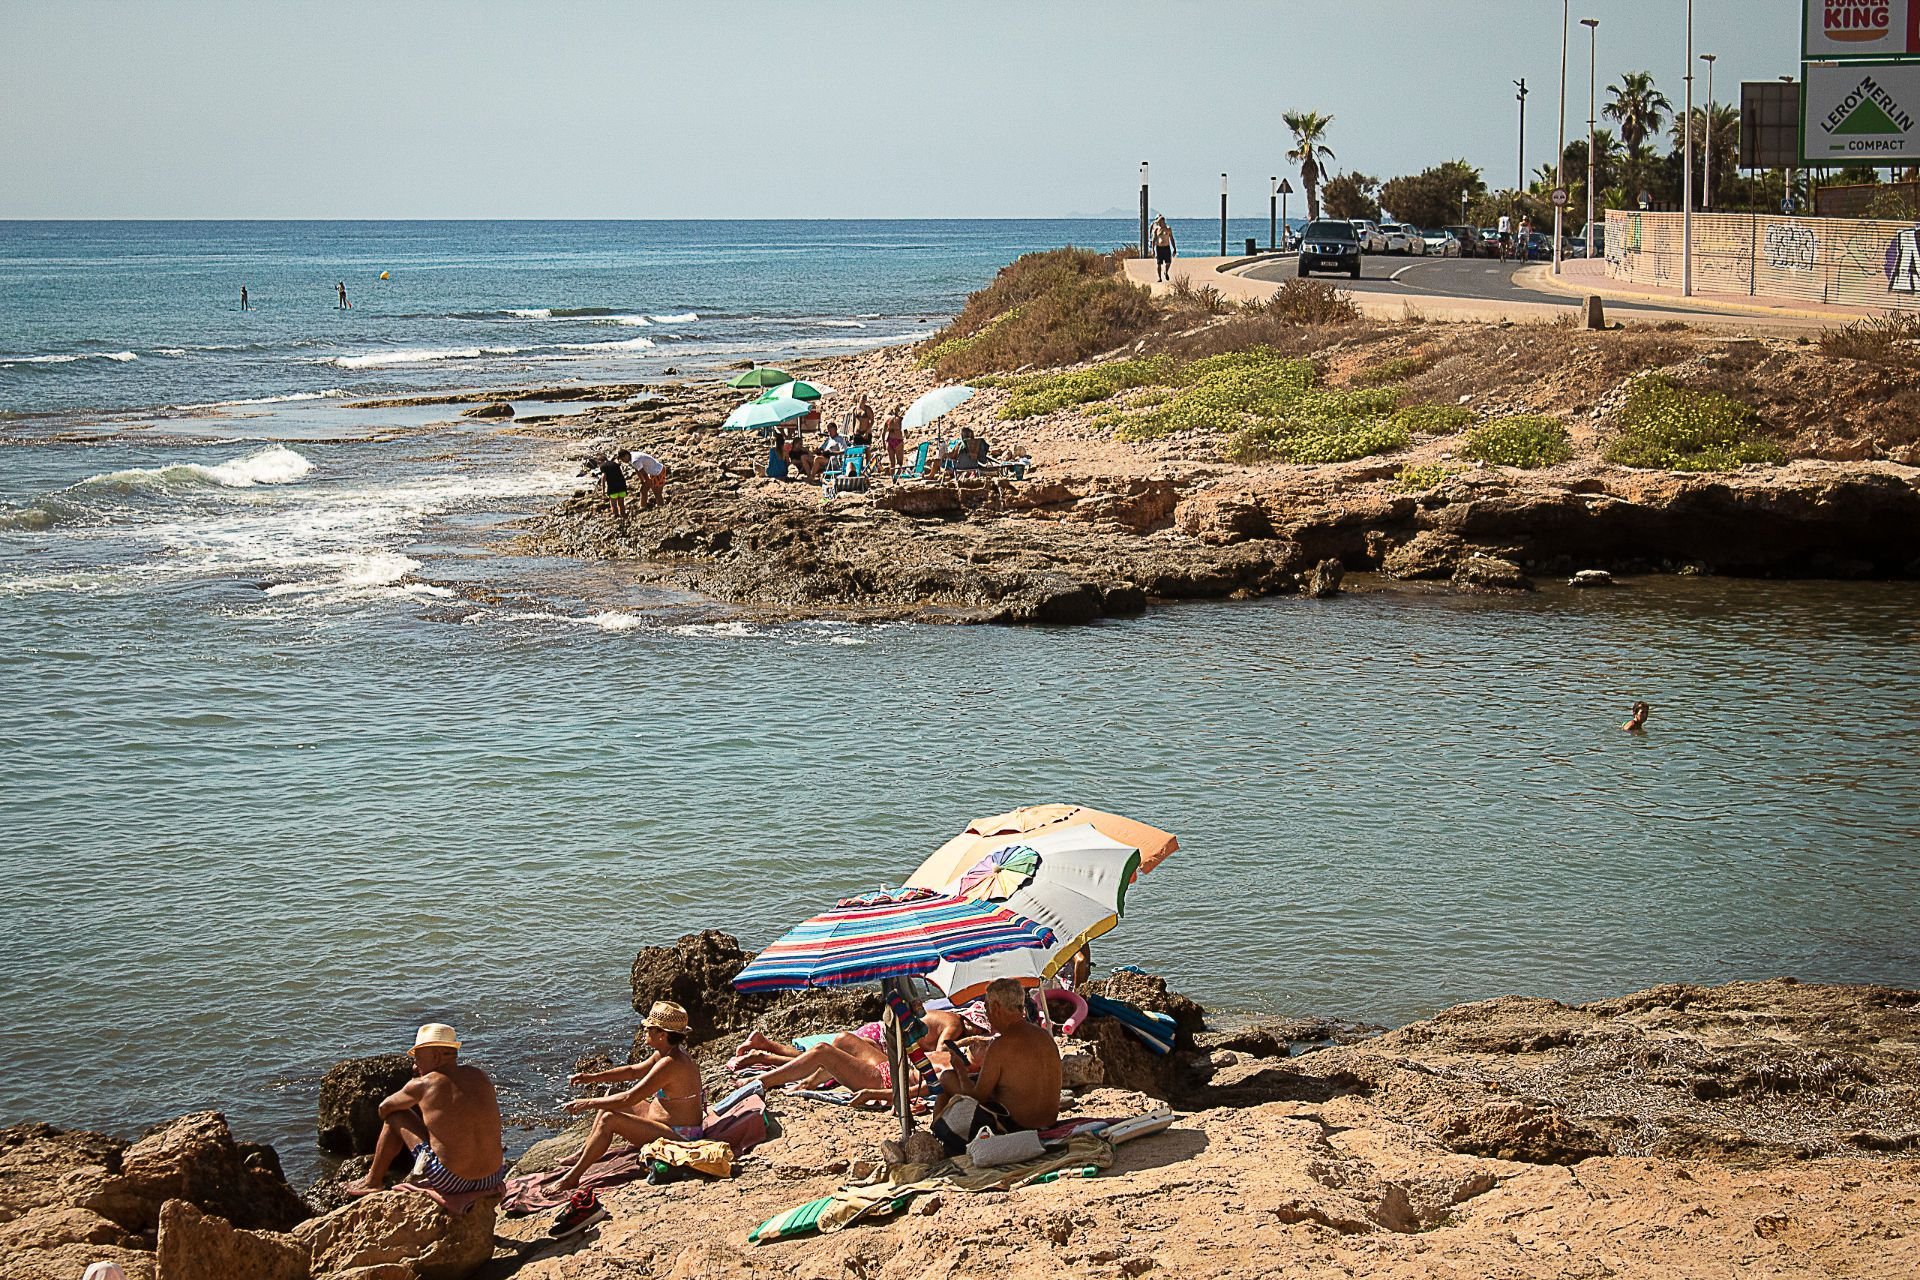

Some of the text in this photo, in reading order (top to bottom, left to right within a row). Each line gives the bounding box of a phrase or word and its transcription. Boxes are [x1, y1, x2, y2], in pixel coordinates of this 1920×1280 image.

[1823, 7, 1889, 29] KING
[1820, 75, 1914, 133] LEROY MERLIN
[1848, 140, 1905, 150] COMPACT
